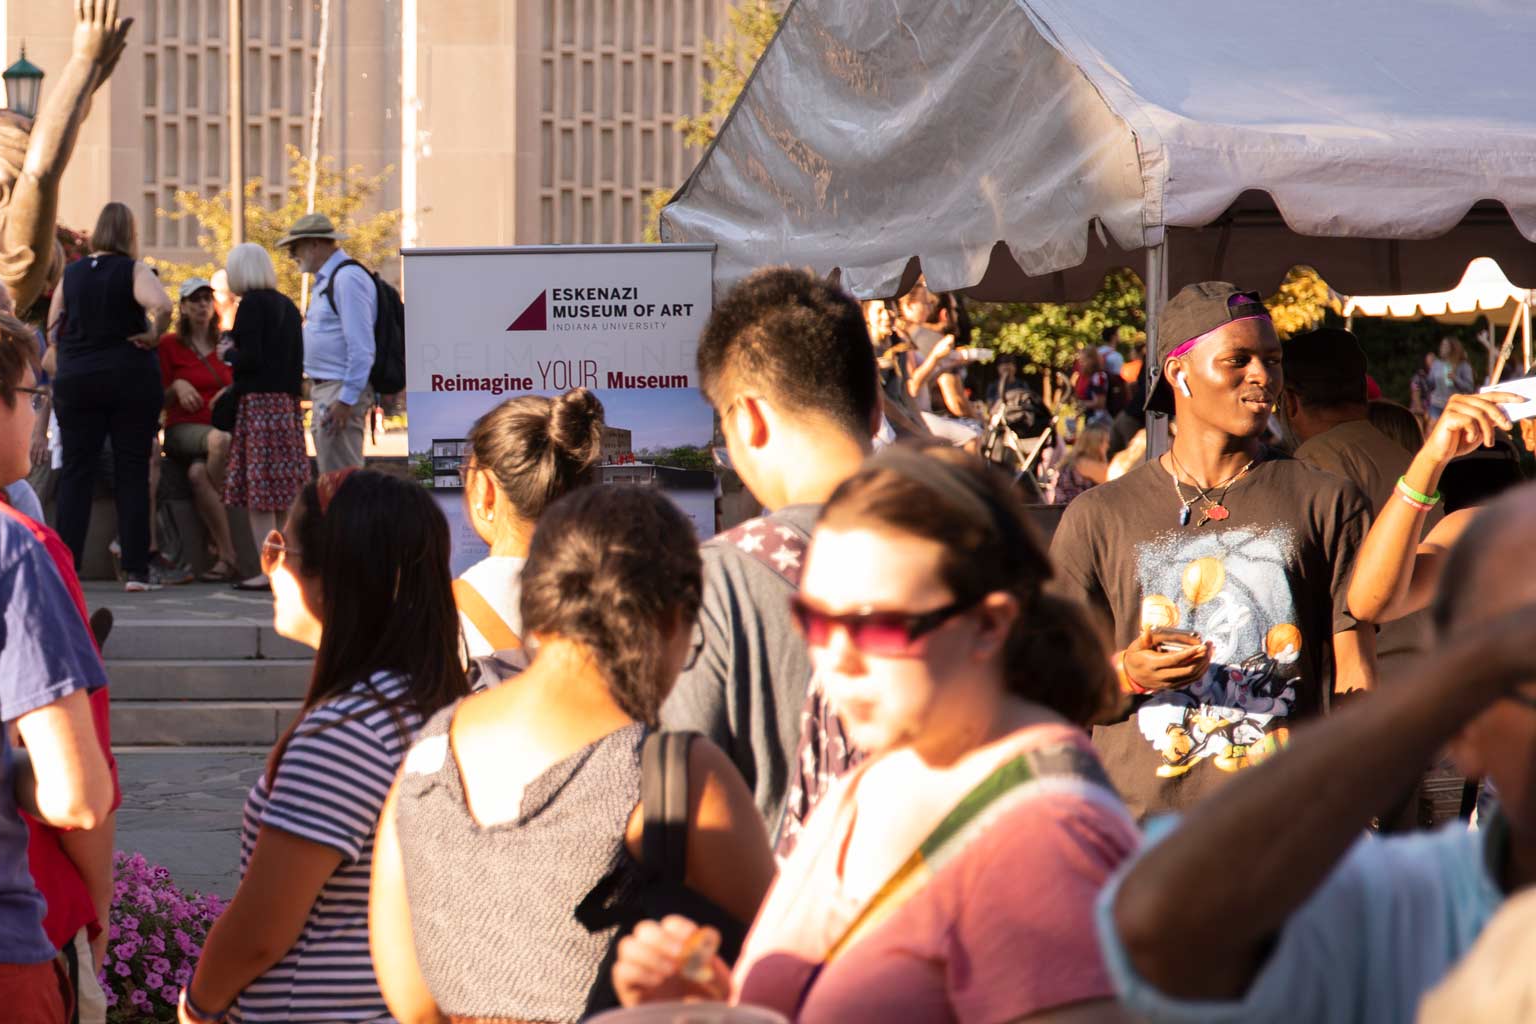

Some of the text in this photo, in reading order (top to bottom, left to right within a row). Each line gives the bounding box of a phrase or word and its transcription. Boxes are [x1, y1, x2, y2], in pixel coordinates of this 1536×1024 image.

[552, 287, 638, 301] ESKENAZI
[552, 304, 694, 318] MUSEUM OF ART
[552, 322, 667, 331] INDIANA UNIVERSITY
[431, 360, 688, 395] Reimagine YOUR Museum
